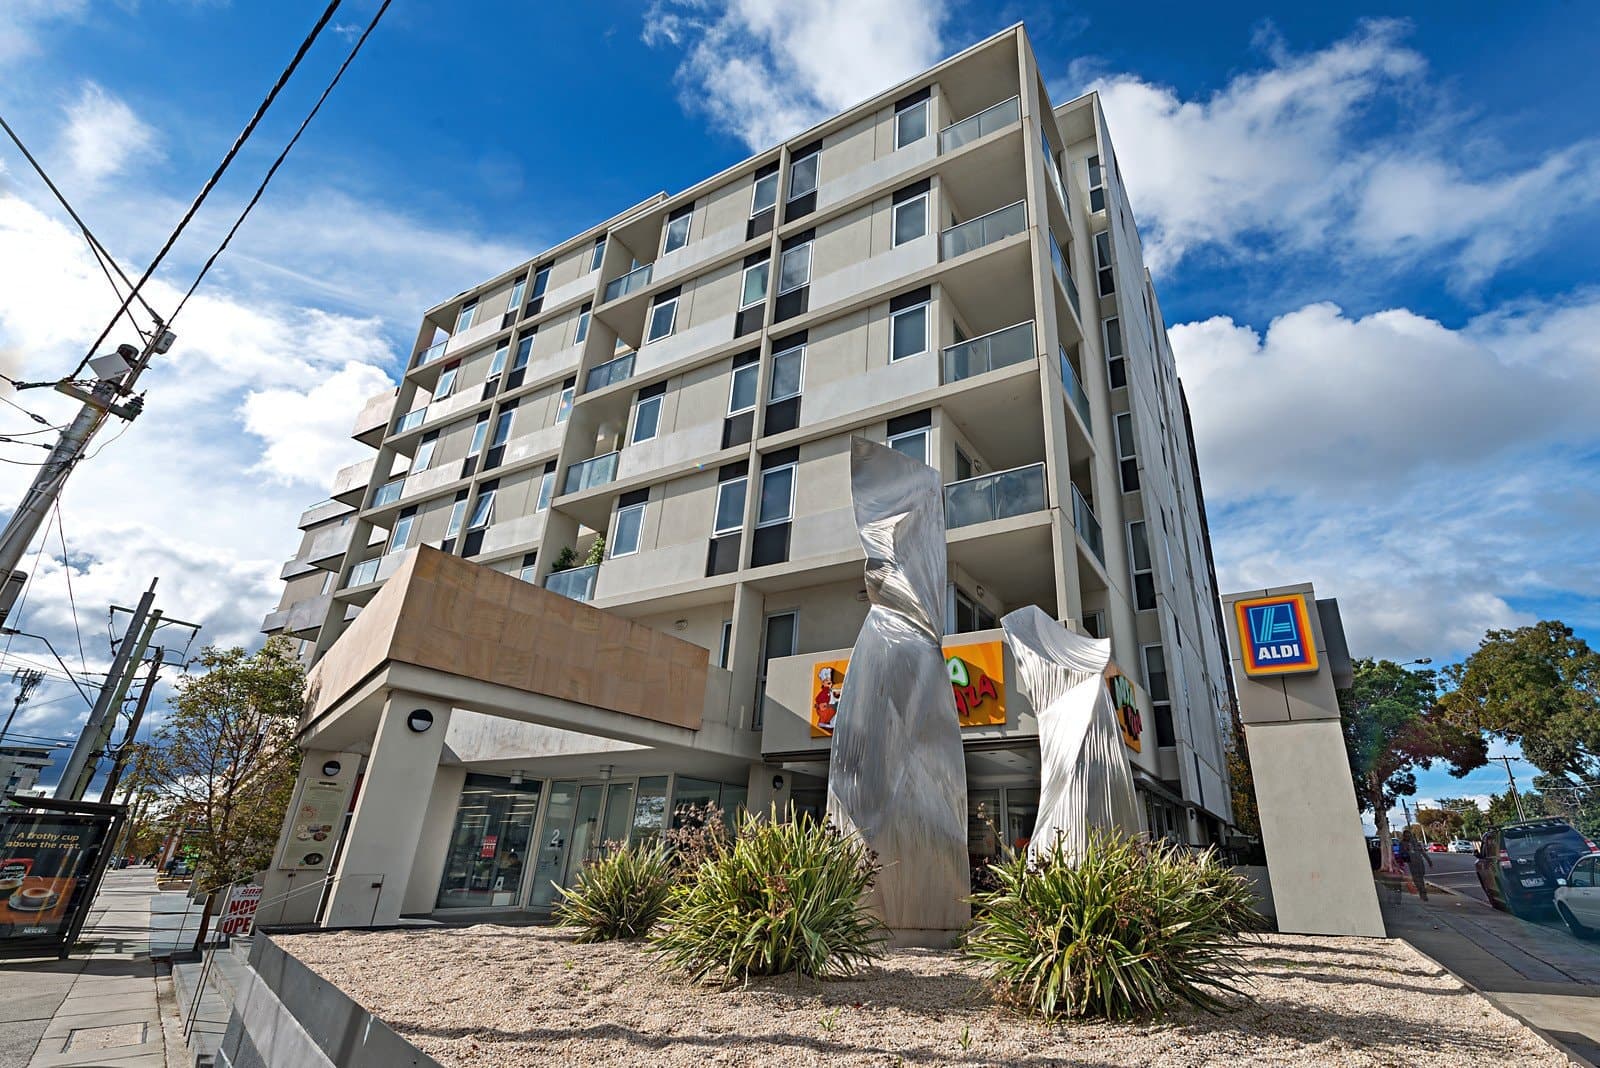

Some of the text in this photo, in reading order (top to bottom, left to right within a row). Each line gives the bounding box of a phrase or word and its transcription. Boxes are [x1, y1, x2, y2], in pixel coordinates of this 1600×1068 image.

[1258, 644, 1300, 660] ALDI
[551, 829, 560, 844] 2
[40, 841, 57, 849] the
[222, 917, 252, 934] OPE
